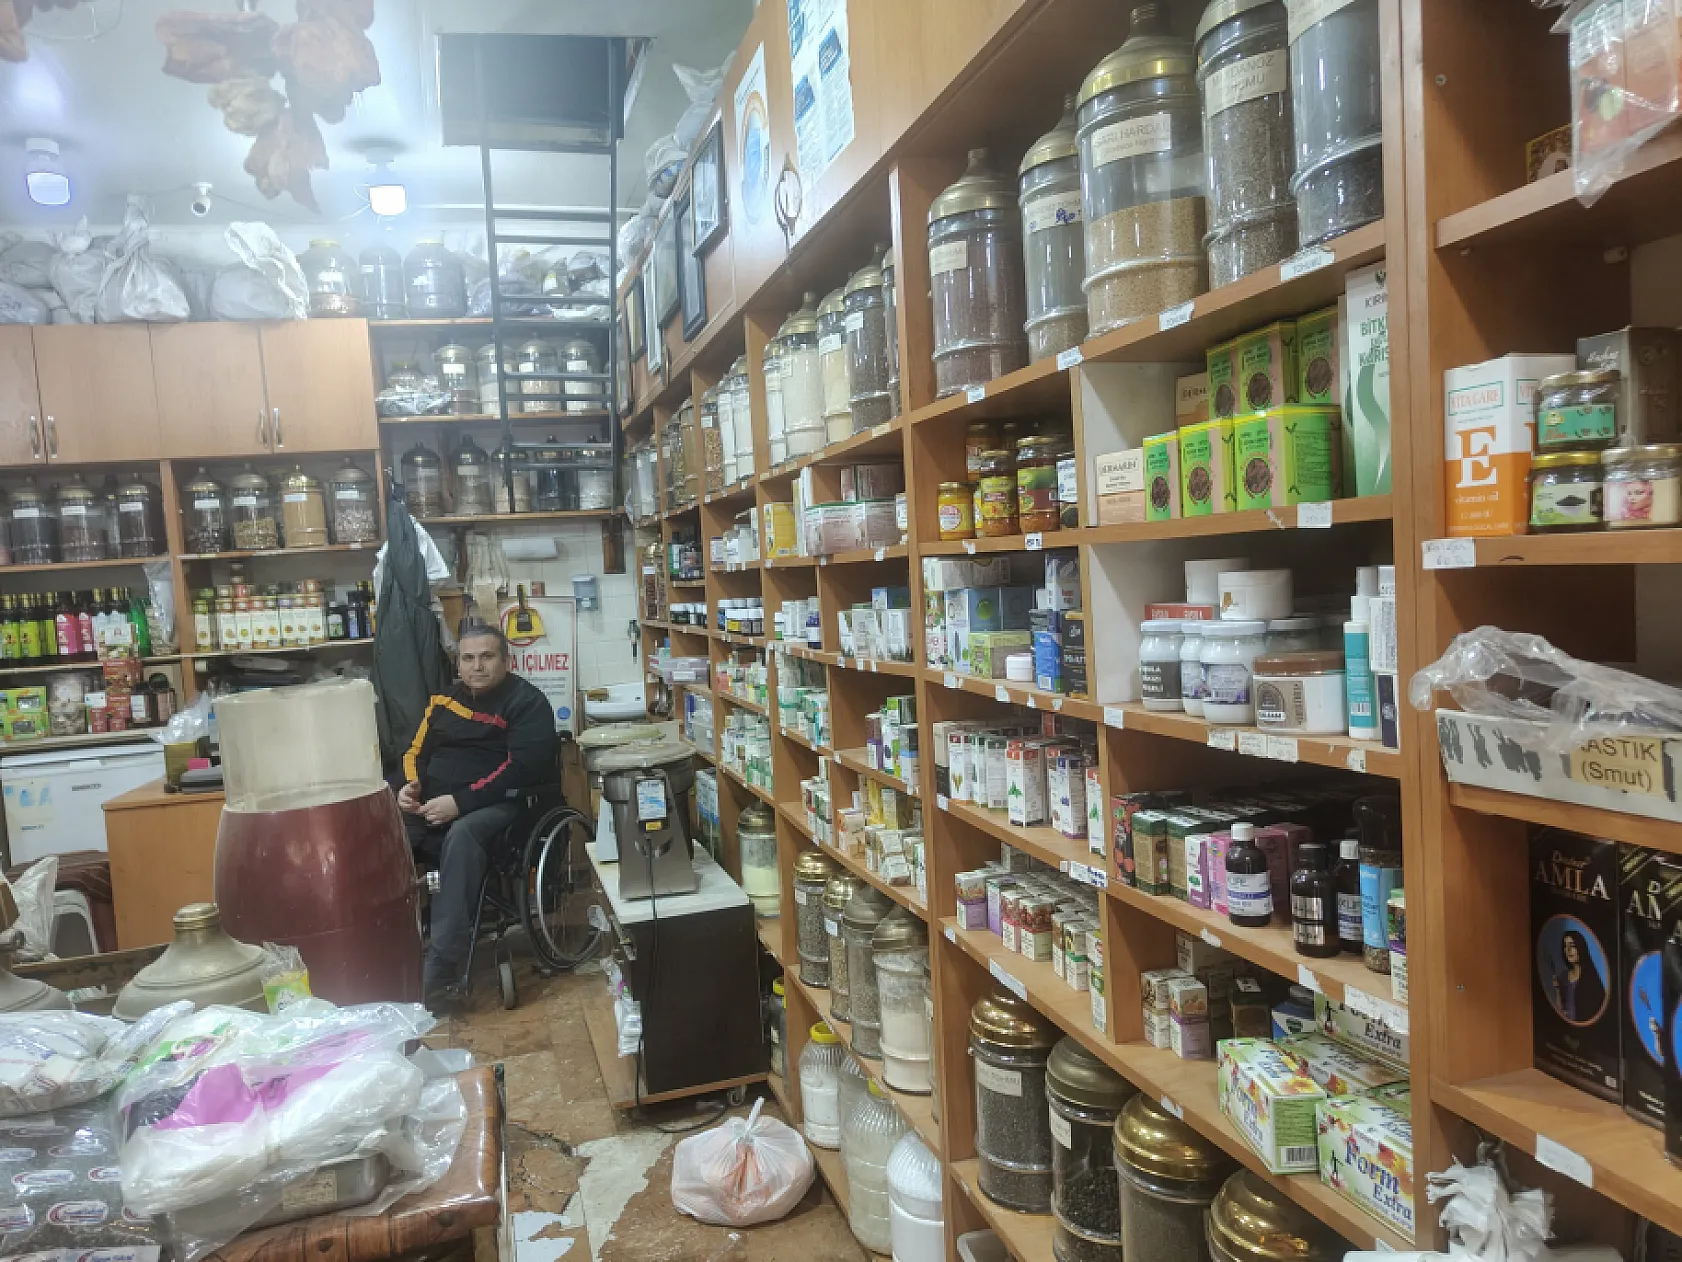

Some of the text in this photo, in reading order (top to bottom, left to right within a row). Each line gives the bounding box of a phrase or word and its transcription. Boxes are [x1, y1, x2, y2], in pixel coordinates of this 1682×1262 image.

[1454, 425, 1498, 489] E
[522, 650, 570, 676] İÇİLMEZ
[1580, 736, 1658, 763] ASTIK
[1581, 760, 1653, 793] (Smut)
[1345, 1138, 1400, 1196] Form
[1373, 1181, 1412, 1221] Extra
